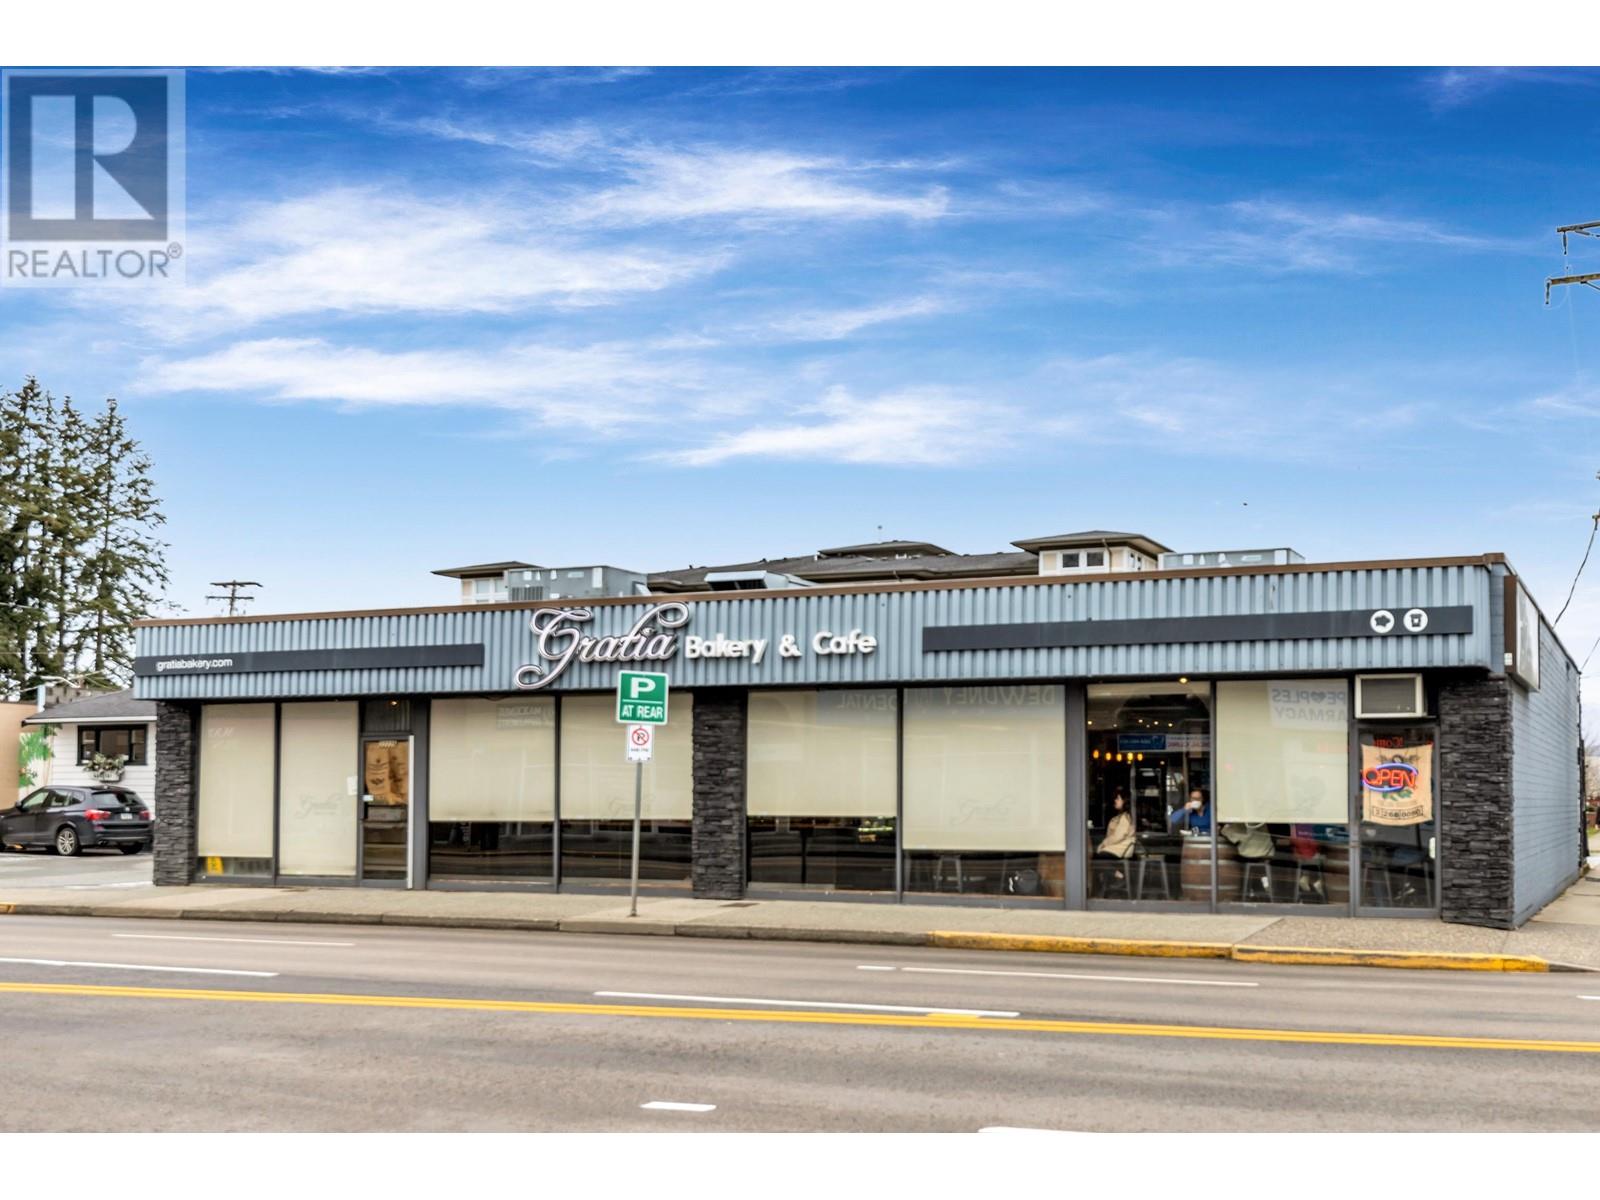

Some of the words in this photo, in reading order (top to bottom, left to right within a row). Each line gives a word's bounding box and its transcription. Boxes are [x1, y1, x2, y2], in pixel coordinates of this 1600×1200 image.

[512, 601, 690, 690] Gratia
[684, 633, 768, 665] Bakery
[778, 634, 803, 657] &
[812, 629, 878, 655] Cafe
[155, 656, 233, 673] gratiabakery.com
[630, 677, 656, 699] P
[621, 704, 634, 718] AT
[636, 705, 663, 719] REAR
[1362, 767, 1416, 788] OPEN
